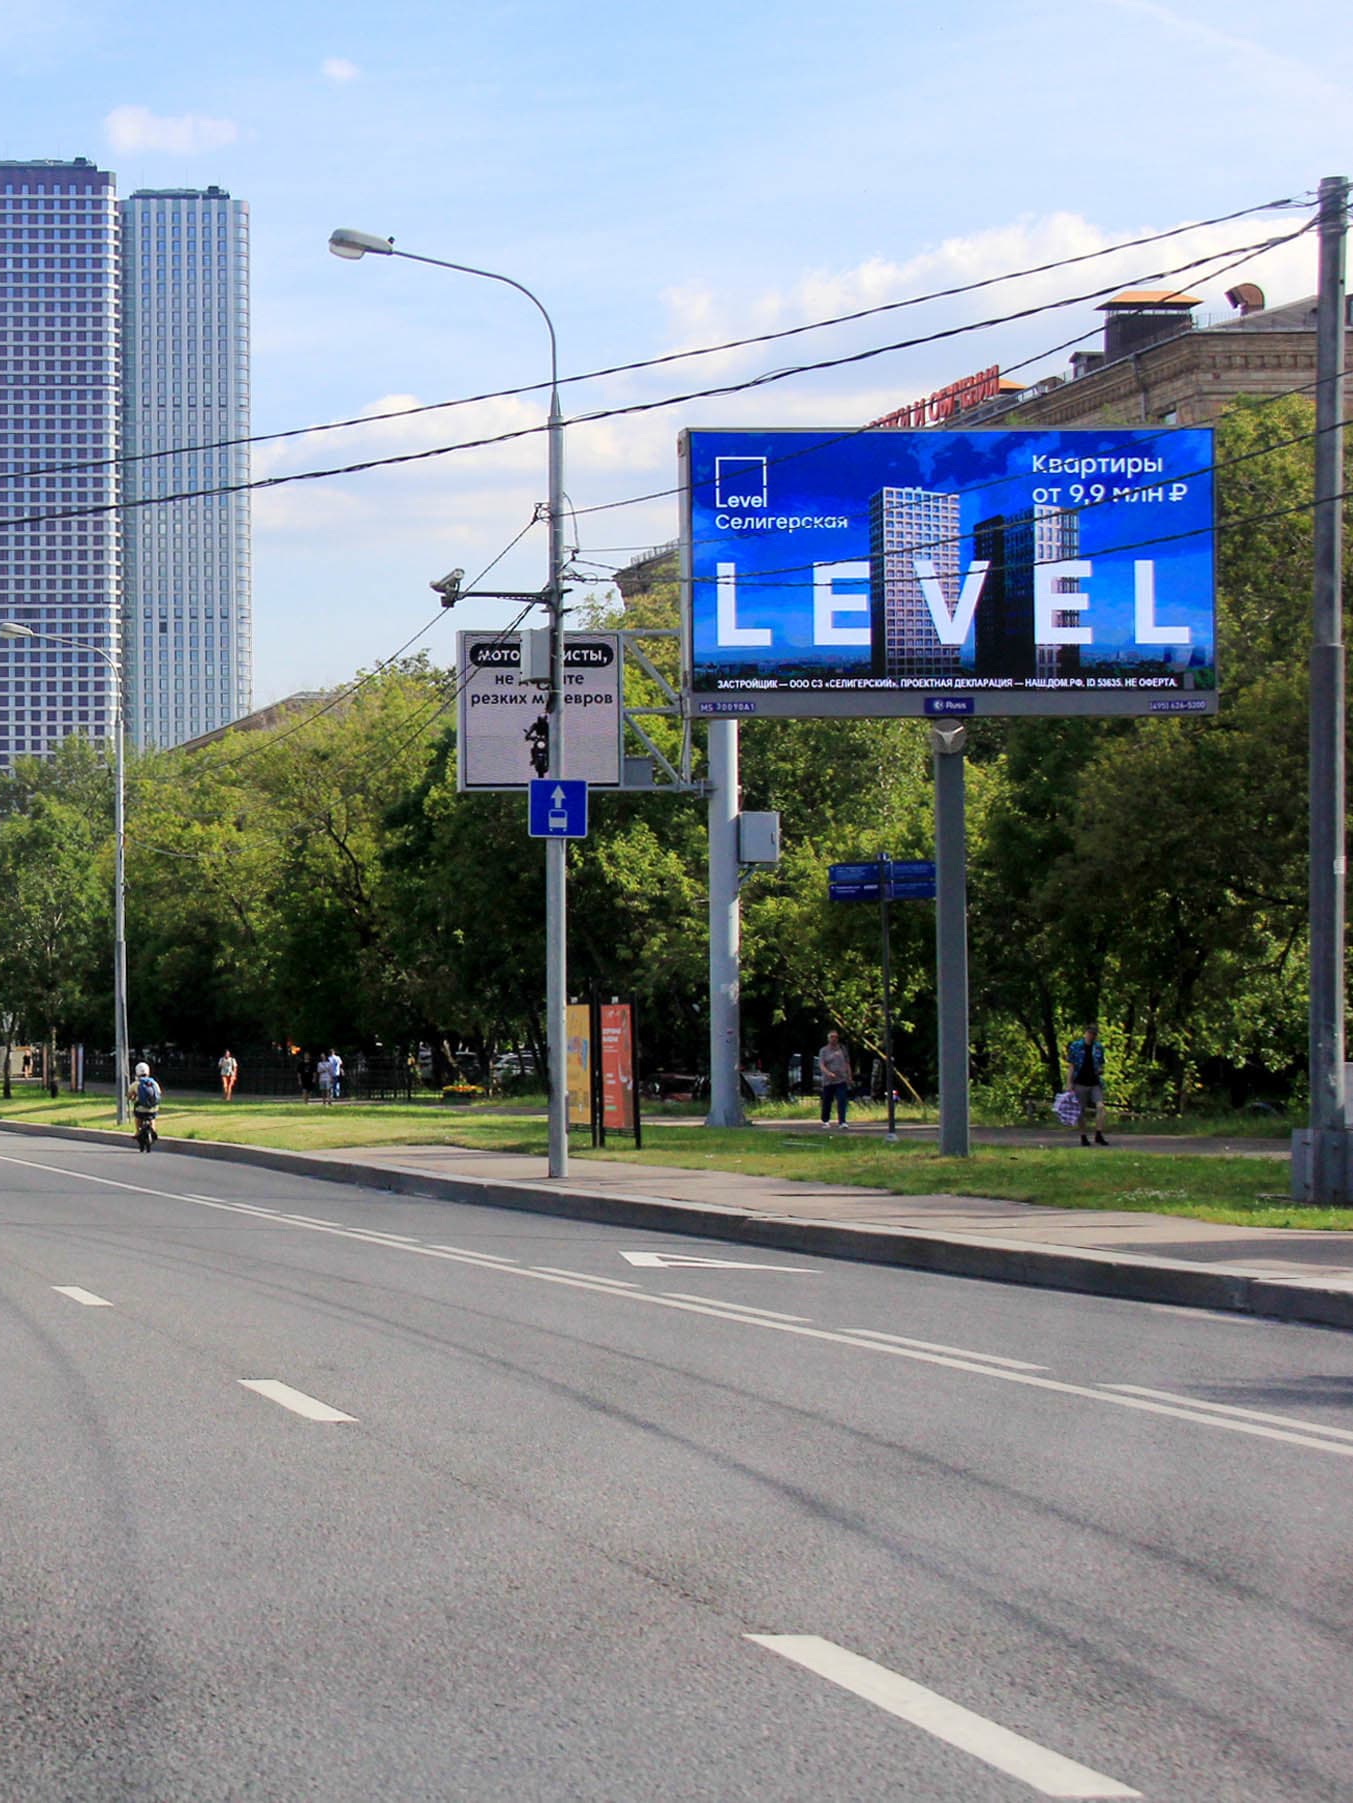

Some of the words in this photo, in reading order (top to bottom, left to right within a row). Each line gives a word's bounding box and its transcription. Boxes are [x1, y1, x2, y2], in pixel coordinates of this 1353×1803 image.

[1032, 454, 1163, 479] Квартиры
[715, 487, 768, 508] Level
[1032, 487, 1062, 504] от
[1069, 483, 1105, 506] 9,9
[1112, 486, 1163, 503] млн
[715, 514, 849, 533] Селигерская
[716, 559, 1192, 647] LEVEL
[478, 649, 608, 663] мотоисты,
[495, 674, 514, 686] не
[717, 678, 778, 690] ЗАСТРОЙЩИК
[789, 679, 809, 689] ООО
[901, 678, 953, 688] ПРОЕКТНАЯ
[954, 678, 1013, 689] ДЕКЛАРАЦИЯ
[1086, 678, 1096, 687] ID
[1124, 678, 1138, 687] НЕ
[471, 693, 528, 707] резких
[532, 693, 613, 707] мевров
